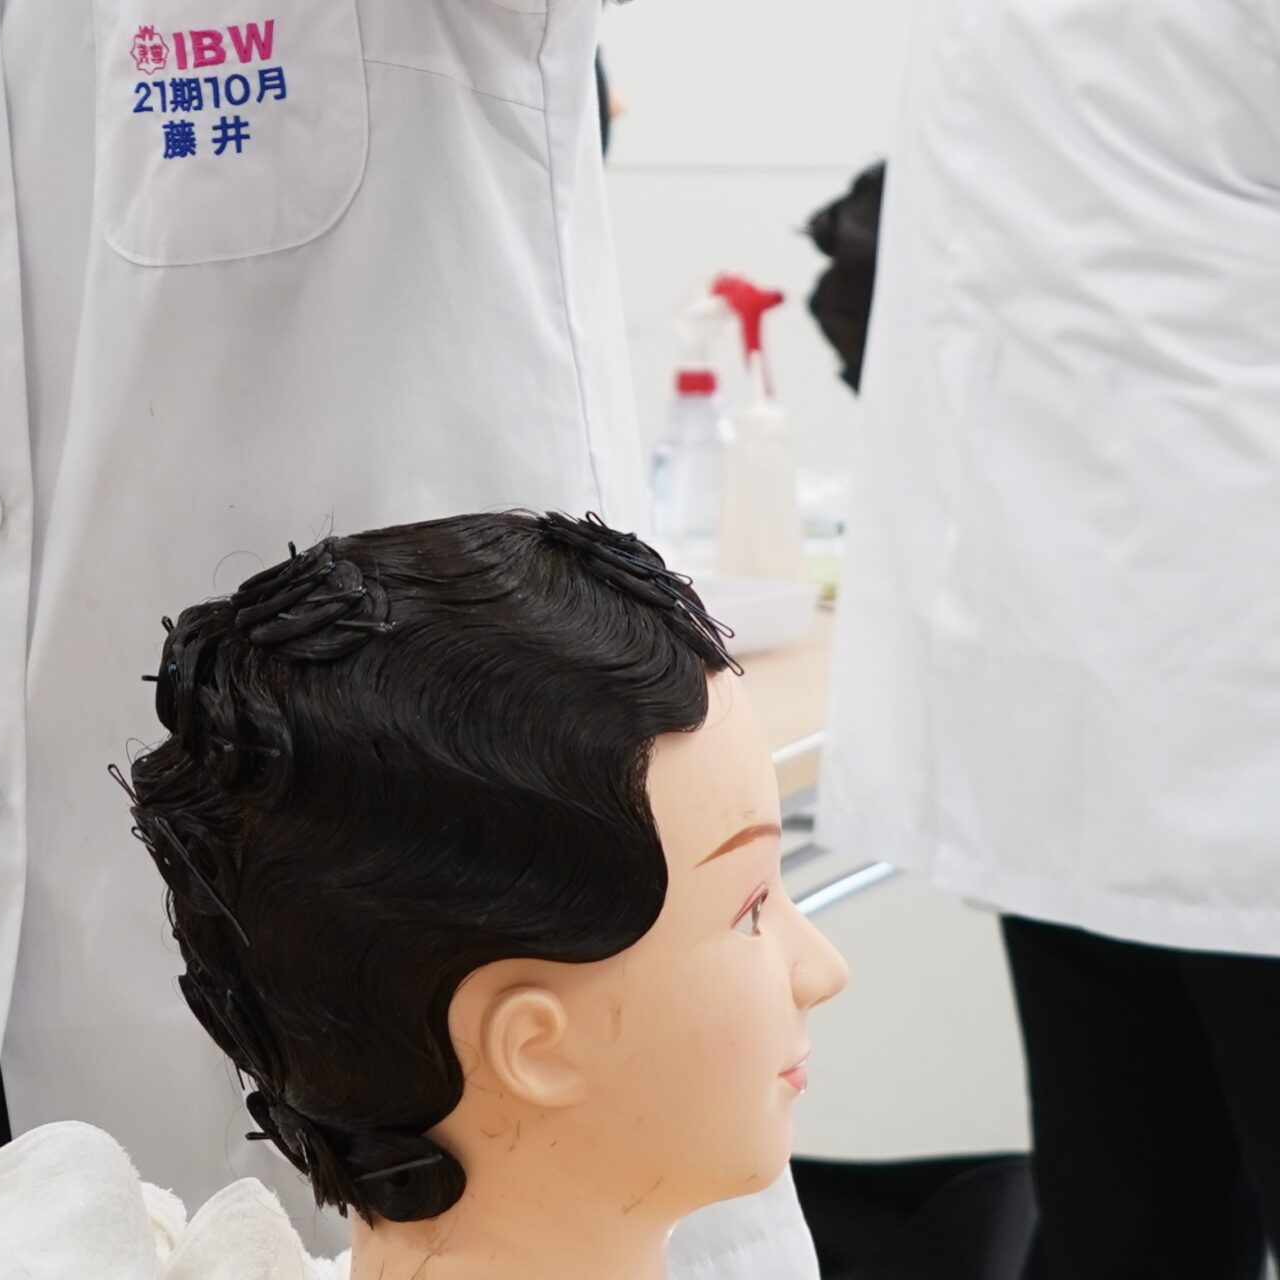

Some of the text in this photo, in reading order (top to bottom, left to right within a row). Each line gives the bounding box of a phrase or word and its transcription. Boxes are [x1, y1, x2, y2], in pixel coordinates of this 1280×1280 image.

[172, 19, 275, 70] IBW
[133, 66, 287, 113] 21期10月
[162, 115, 251, 159] 藤井
